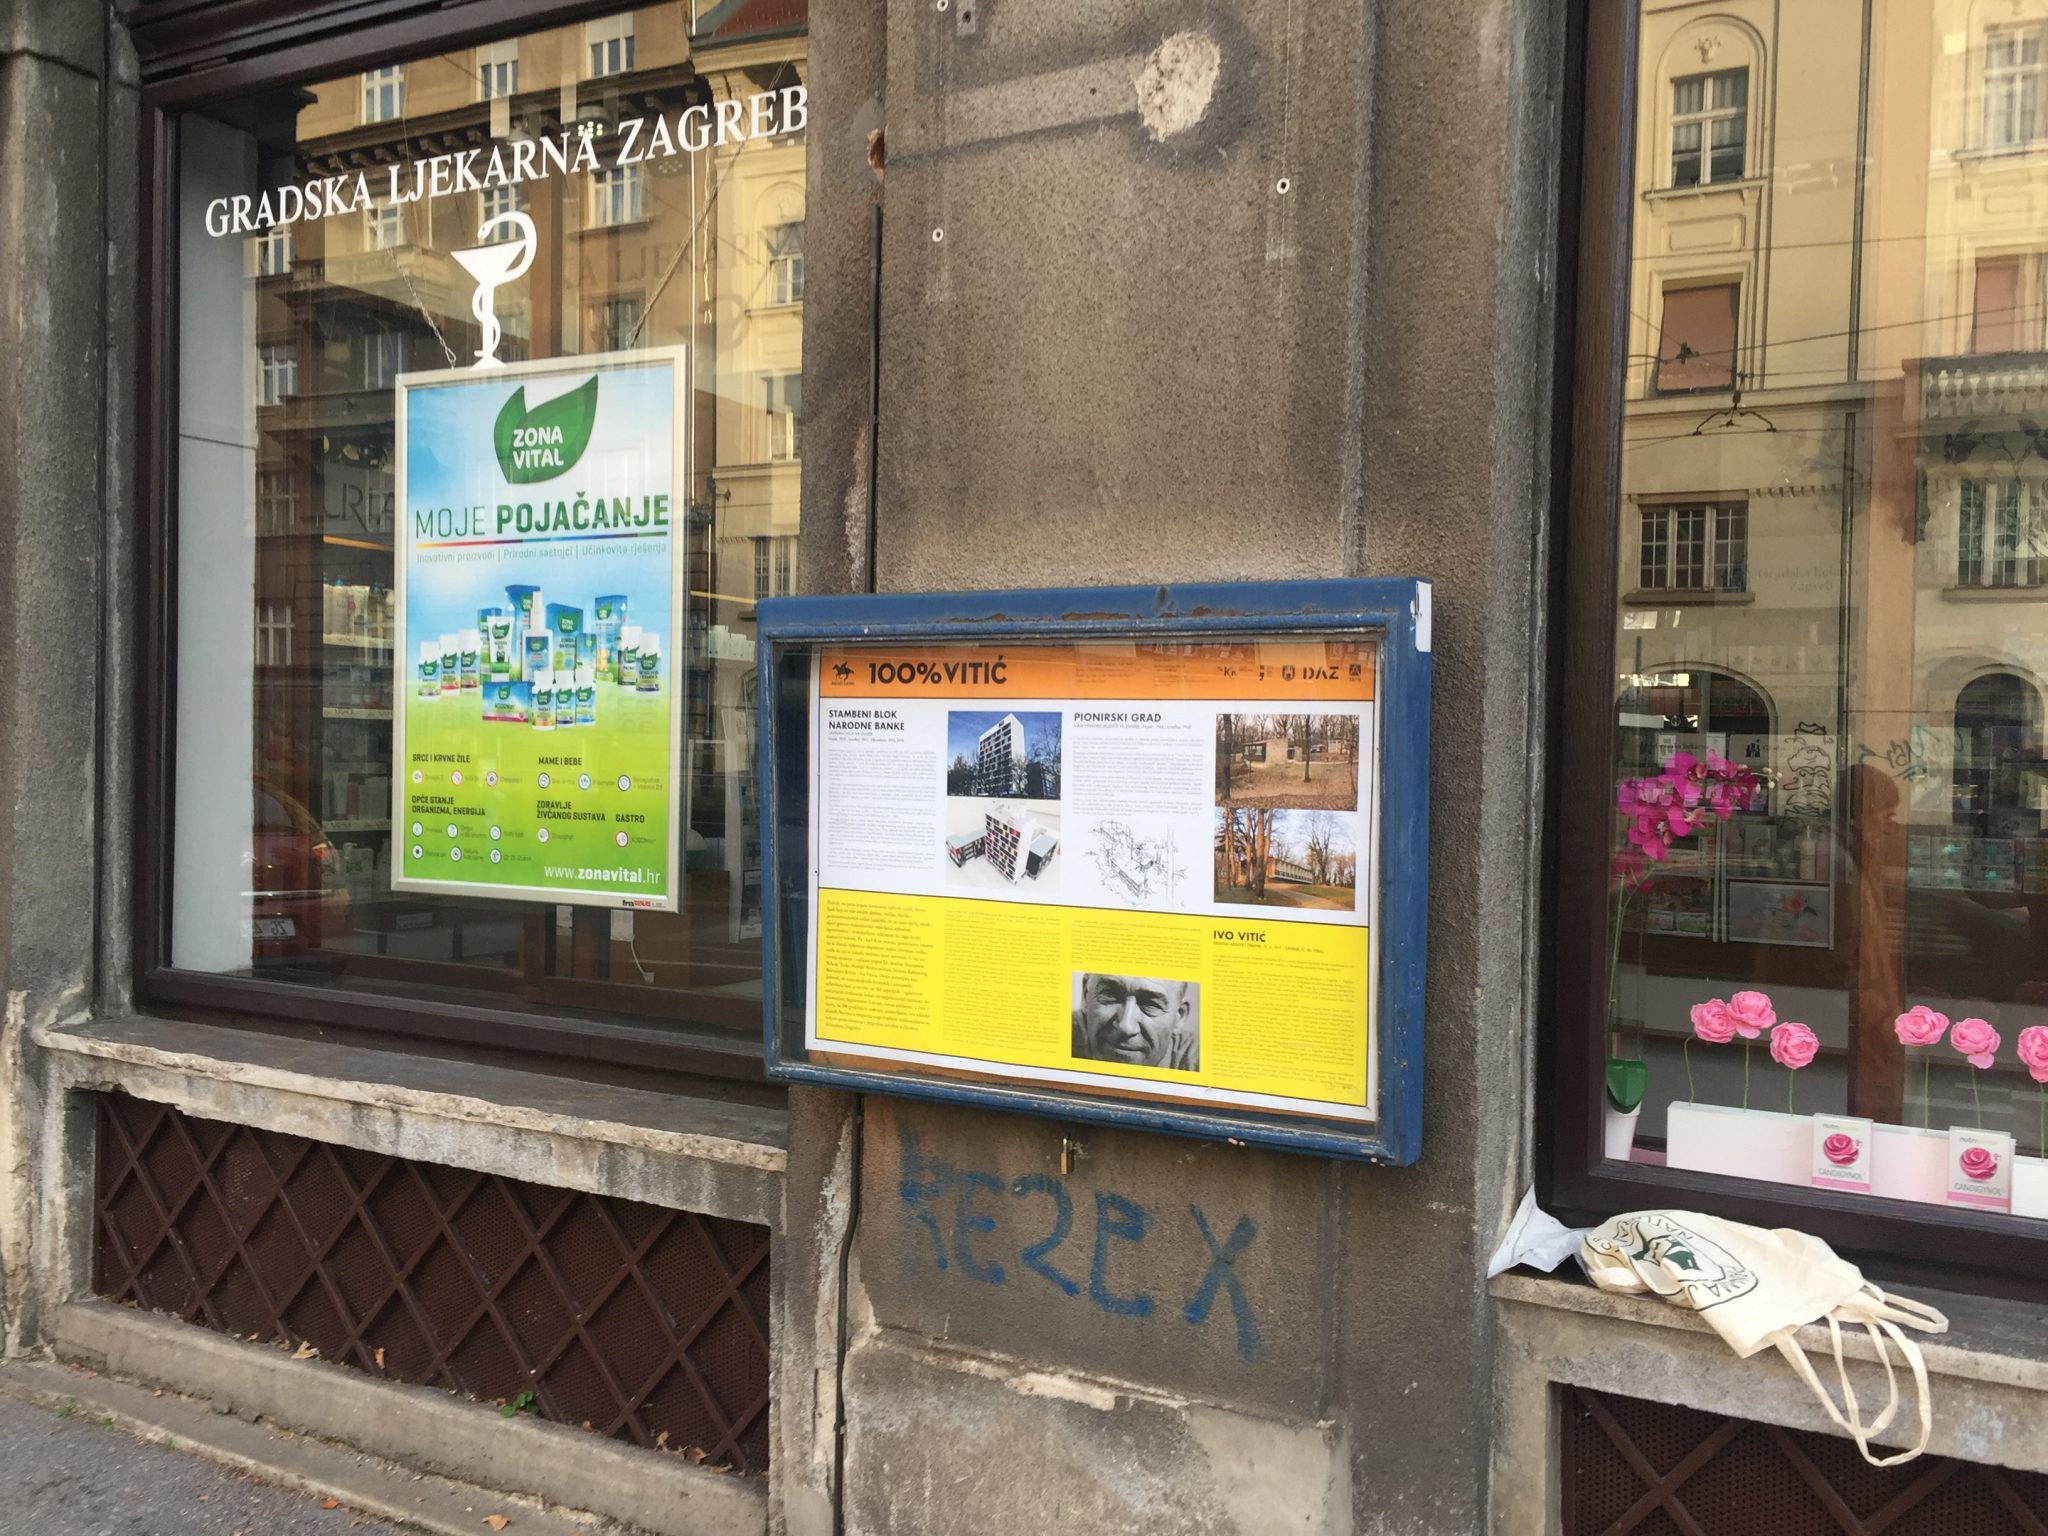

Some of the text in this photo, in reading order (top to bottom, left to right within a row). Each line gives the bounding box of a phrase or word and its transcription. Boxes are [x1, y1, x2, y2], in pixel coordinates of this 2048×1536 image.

[205, 84, 809, 238] GRADSKA LJEKARNA ZAGREB
[513, 425, 563, 448] ZONA
[512, 448, 564, 469] VITAL
[416, 491, 669, 539] MOJE POJAČANJE
[416, 550, 495, 563] Inovativni proizvodi
[503, 548, 537, 559] Prirodni
[828, 709, 898, 719] STAMBENI BLOK
[1074, 712, 1162, 723] PIONIRSKI GRAD
[828, 721, 905, 731] NARODNE BANKE
[434, 754, 455, 763] KRVNE
[538, 756, 558, 766] MAME
[564, 757, 582, 766] BEBE
[430, 795, 455, 805] STANJE
[536, 799, 572, 811] ZDRAVLJE
[572, 811, 606, 822] SUSTAVA
[615, 813, 645, 824] GASTRO
[543, 866, 660, 885] www.zonavital.hr
[1213, 930, 1266, 942] IVO VITIĆ
